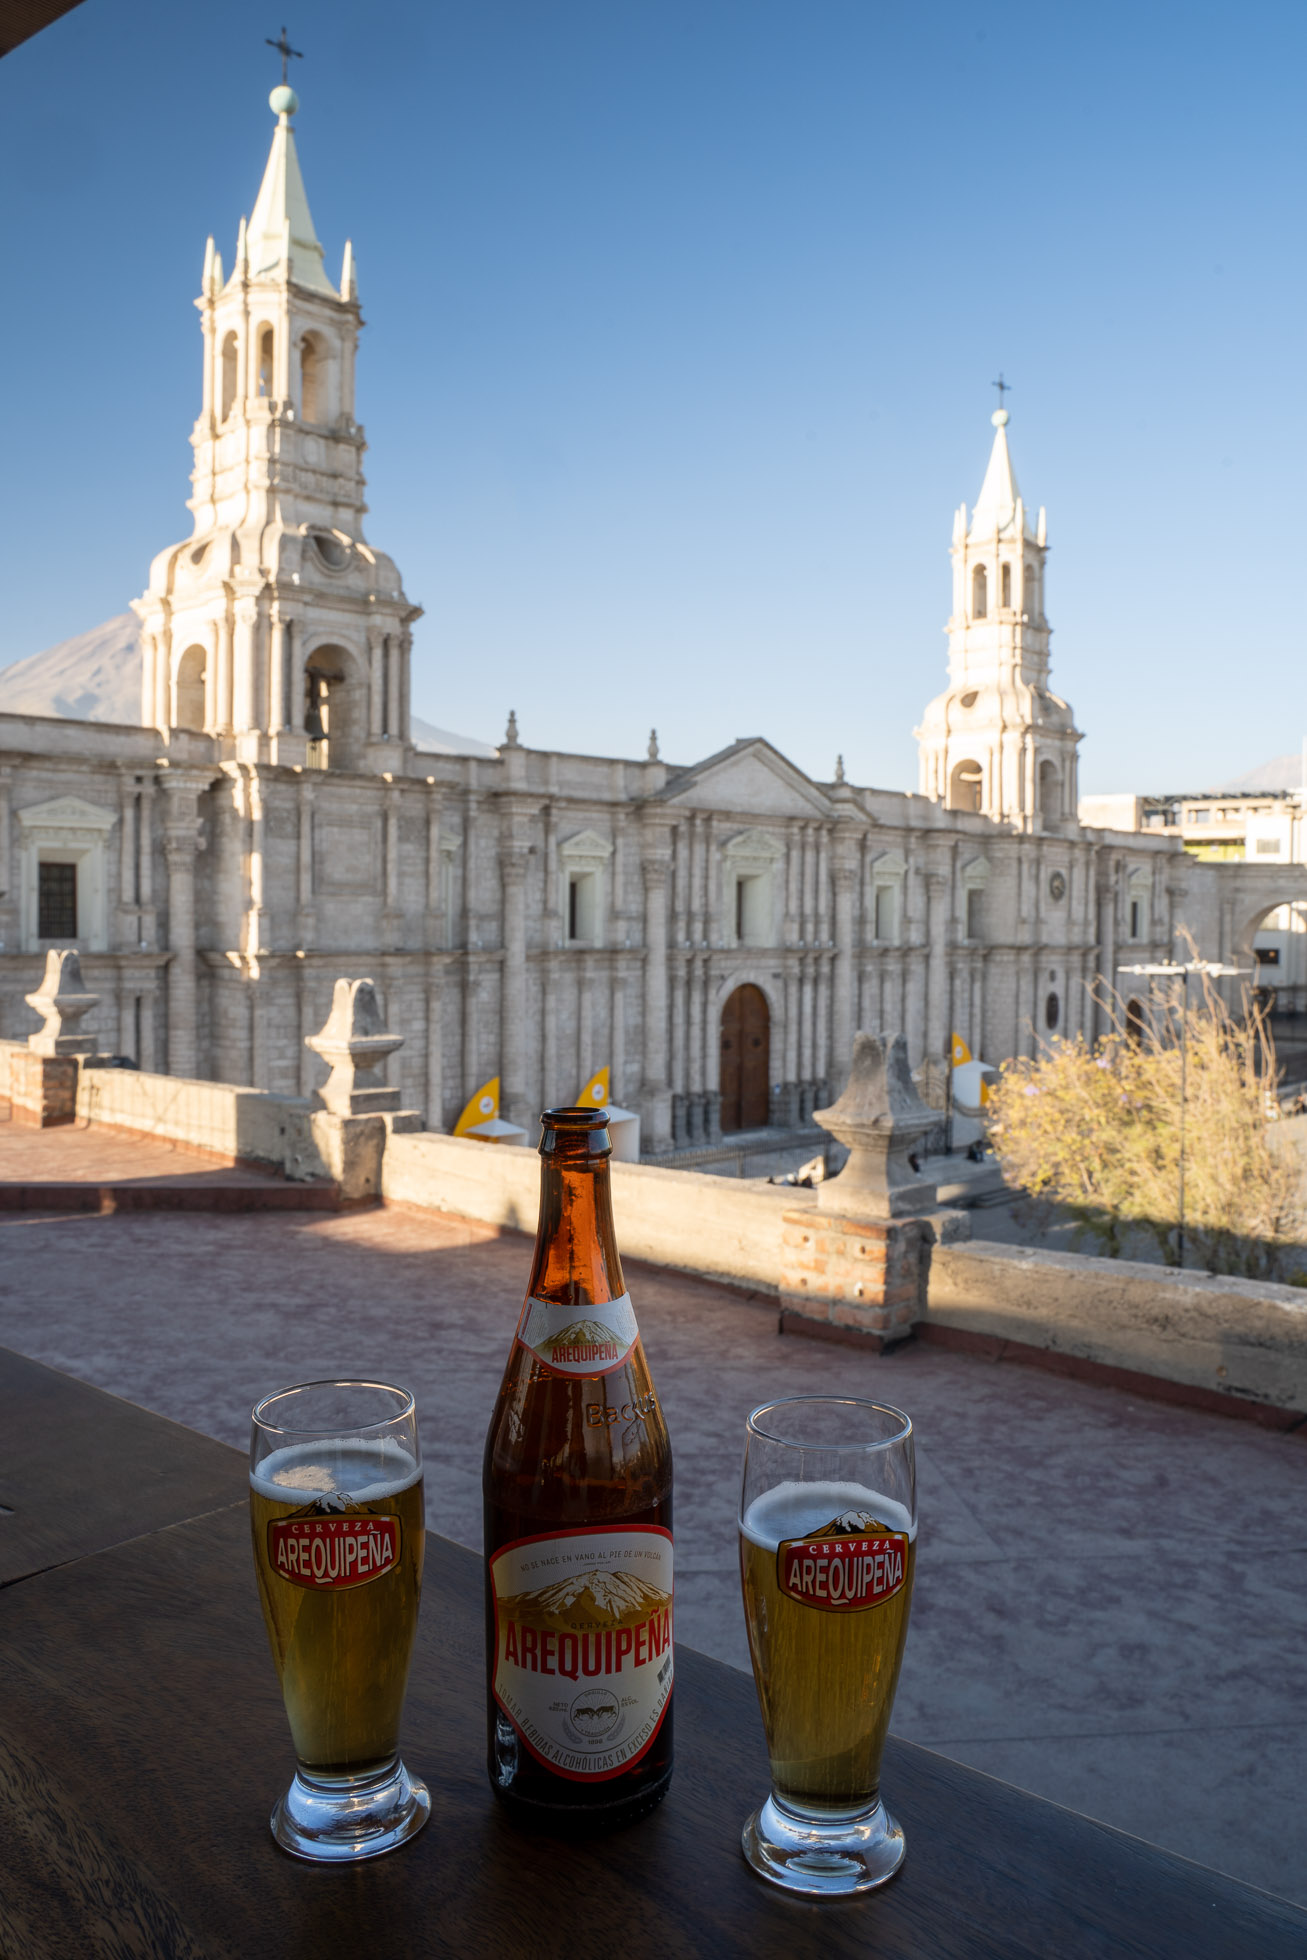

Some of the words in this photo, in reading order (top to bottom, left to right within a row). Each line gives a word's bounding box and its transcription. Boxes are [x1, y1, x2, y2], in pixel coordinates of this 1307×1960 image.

[552, 1341, 619, 1363] AREQUIPEÑA
[586, 1391, 656, 1428] Backus
[291, 1521, 375, 1534] CERVEZA
[277, 1530, 393, 1584] AREQUIPEÑA
[520, 1563, 530, 1572] NO
[530, 1560, 540, 1569] SE
[541, 1556, 561, 1567] NACE
[561, 1554, 572, 1563] EN
[575, 1552, 595, 1561] VANO
[597, 1551, 607, 1559] AL
[609, 1550, 622, 1559] PIE
[623, 1550, 633, 1558] DE
[808, 1540, 891, 1555] CERVEZA
[788, 1549, 903, 1605] AREQUIPEÑA
[570, 1618, 624, 1631] CERVEZA
[504, 1605, 670, 1682] AREQUIPEÑA
[498, 1684, 522, 1719] TOMAR
[520, 1717, 554, 1756] BEBIDAS
[551, 1749, 614, 1771] ALCOHÓLICAS
[615, 1747, 628, 1763] EN
[627, 1722, 653, 1753] EXCESO
[649, 1708, 660, 1722] ES
